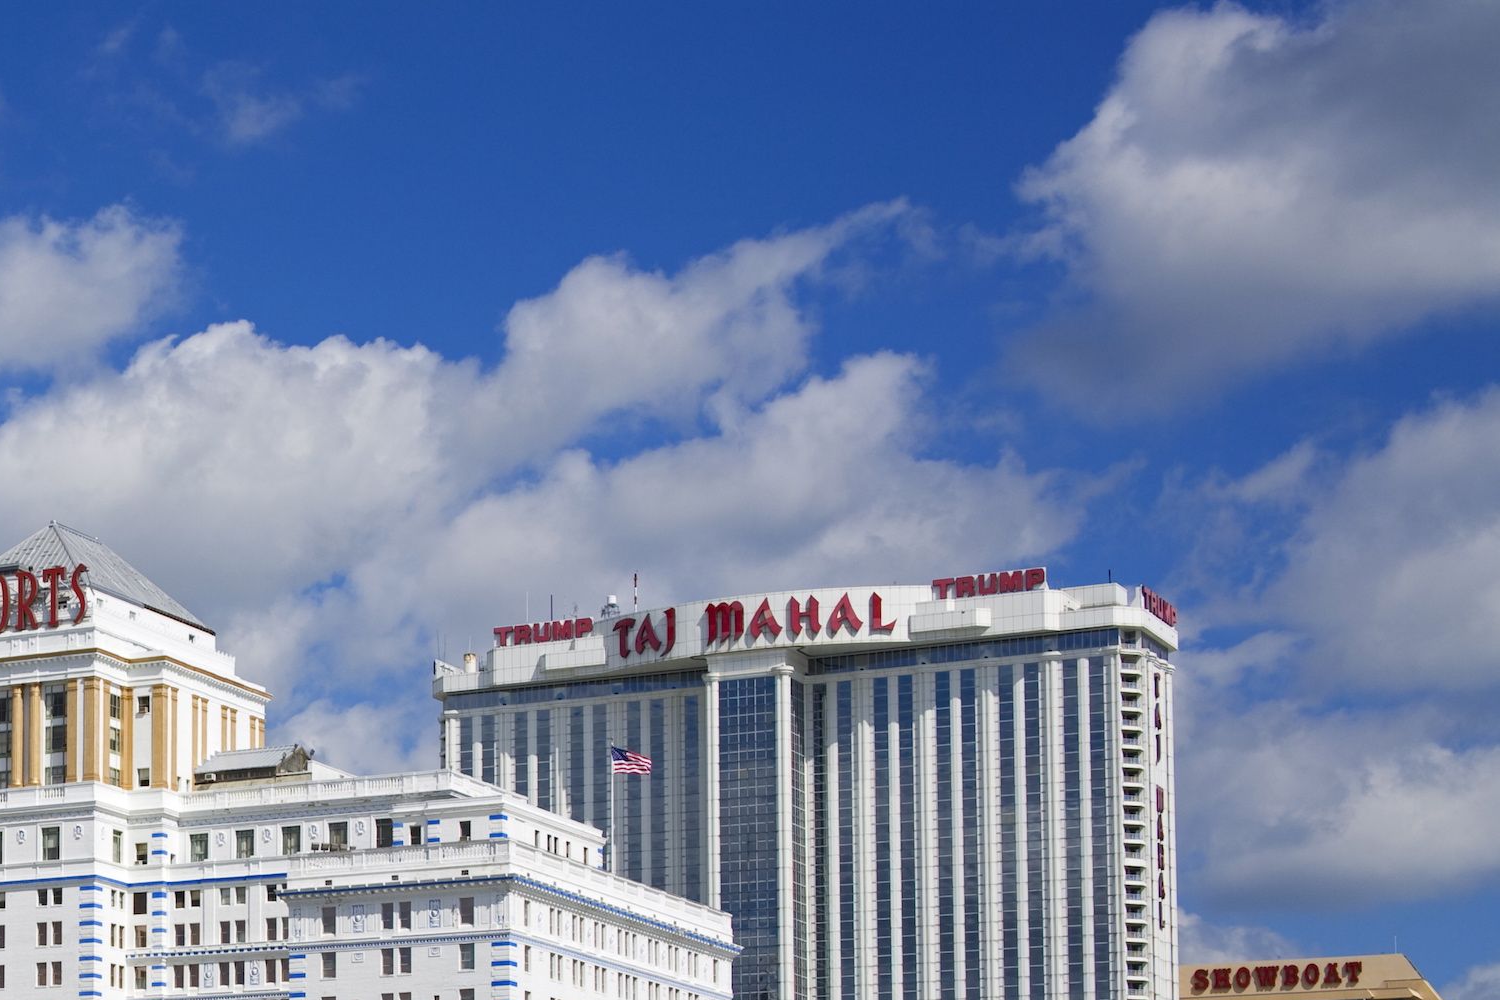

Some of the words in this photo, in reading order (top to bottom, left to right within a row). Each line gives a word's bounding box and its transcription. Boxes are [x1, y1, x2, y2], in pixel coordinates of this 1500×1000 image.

[932, 568, 1045, 600] TRUMP
[493, 617, 594, 647] TRUMP
[613, 607, 676, 659] TAJ
[705, 592, 897, 646] MAHAL
[1193, 961, 1362, 991] SHOWBOAT
